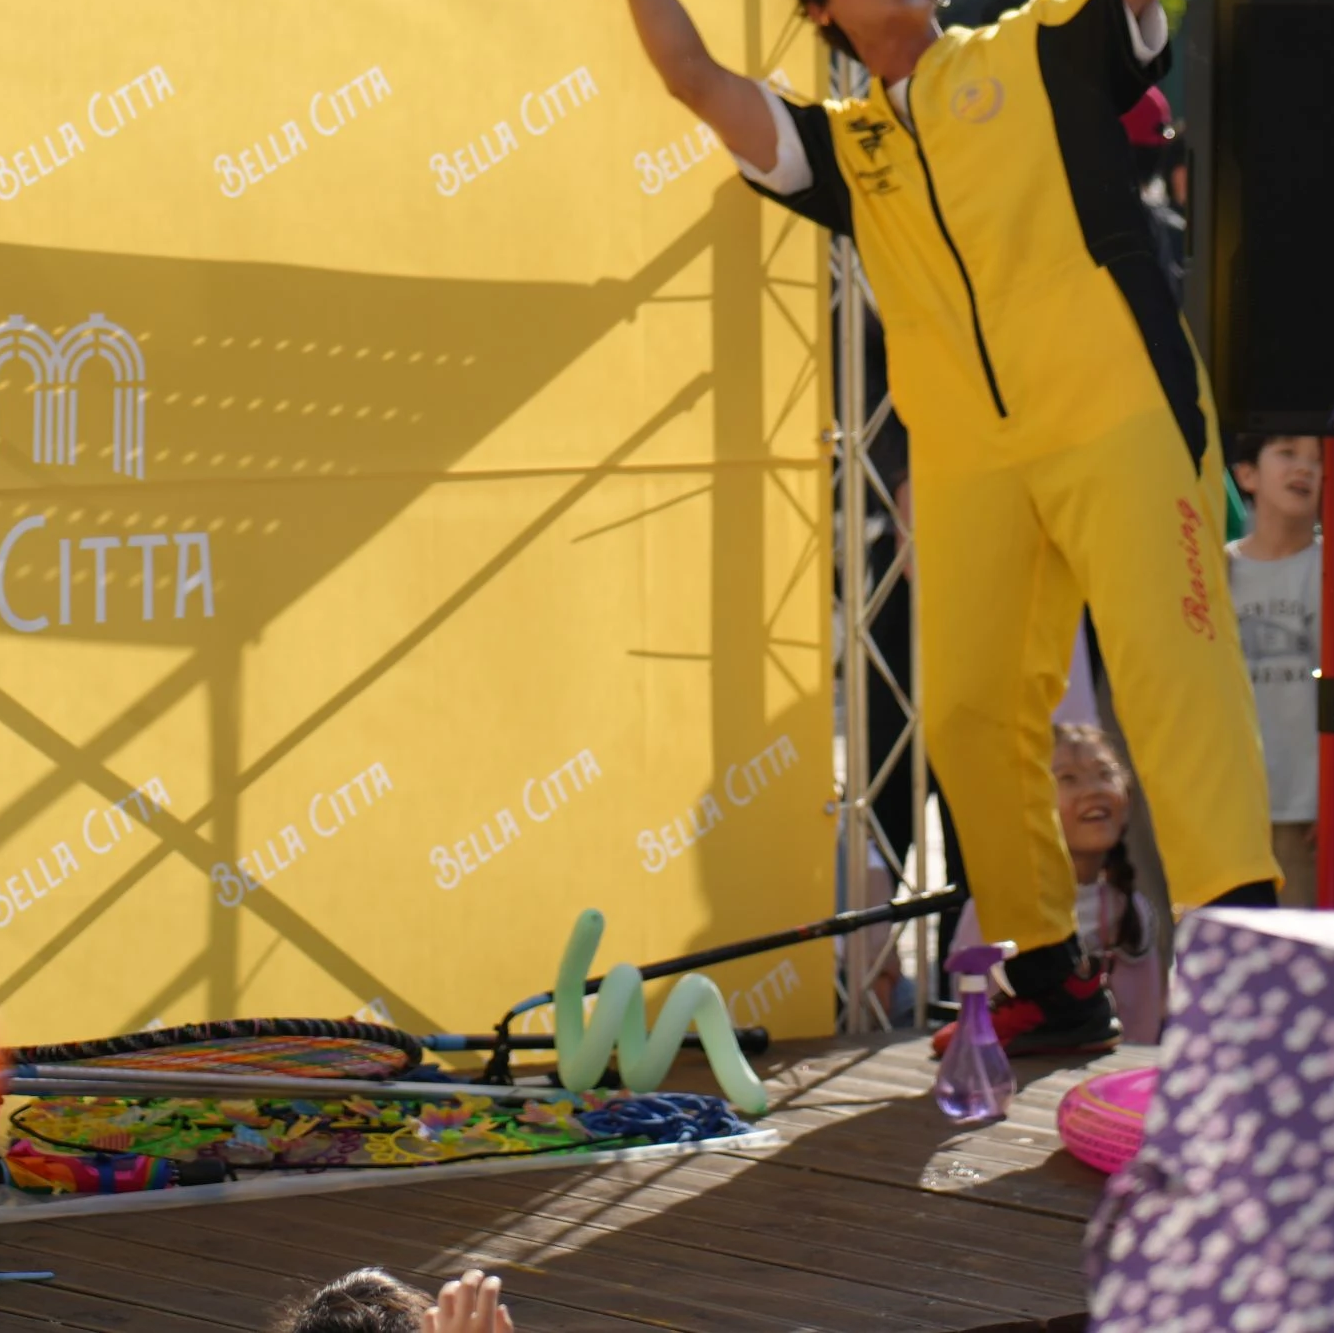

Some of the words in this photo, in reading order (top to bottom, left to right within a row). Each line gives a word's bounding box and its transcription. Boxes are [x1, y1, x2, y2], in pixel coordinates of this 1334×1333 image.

[87, 65, 175, 137] CITTA
[213, 119, 307, 199] BELLA
[309, 65, 393, 137] CITTA
[428, 121, 519, 197] BELLA
[519, 65, 600, 136] CITTA
[634, 122, 719, 195] BELLA
[81, 775, 173, 855] CITTA
[210, 823, 307, 908] BELLA
[308, 761, 394, 838] CITTA
[428, 805, 521, 890] BELLA
[522, 748, 603, 823] CITTA
[636, 791, 724, 874] BELLA
[724, 733, 801, 807] CITTA
